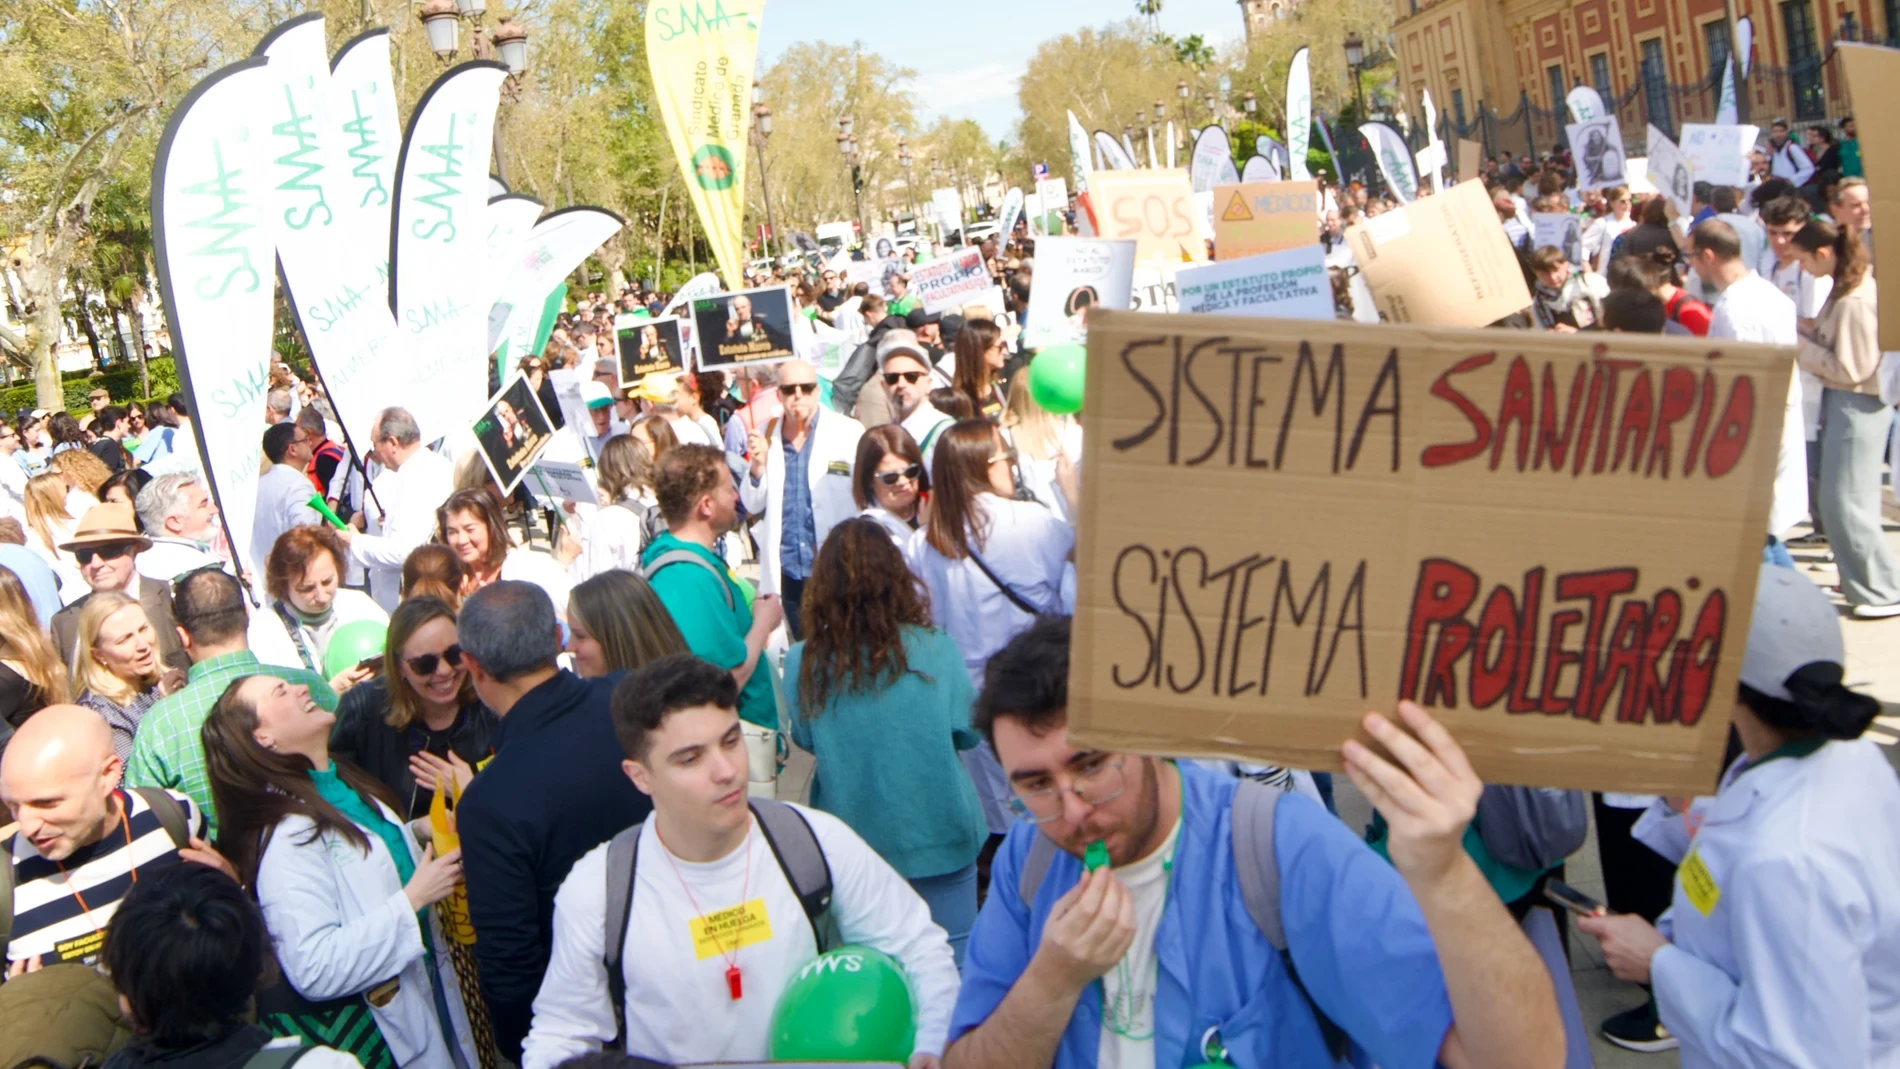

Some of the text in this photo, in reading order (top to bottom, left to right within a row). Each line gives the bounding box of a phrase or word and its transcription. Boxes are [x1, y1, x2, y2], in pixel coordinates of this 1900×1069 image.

[718, 56, 729, 76] de
[688, 60, 708, 137] Sindicato
[726, 74, 746, 141] Granada
[1111, 194, 1194, 240] SOS
[918, 265, 984, 293] PROPIO
[1181, 264, 1323, 297] POR UN ESTATUTO PROPIO
[1204, 279, 1298, 302] DE LA PROFESIÓN
[1191, 285, 1319, 313] MÉDICA Y FACULTATIVA
[1111, 335, 1756, 481] SISTEMA SANITARIO
[1397, 555, 1729, 728] PROLETARIO
[704, 924, 718, 936] EN
[718, 912, 757, 930] HUELGA
[708, 905, 745, 923] MÉDICO
